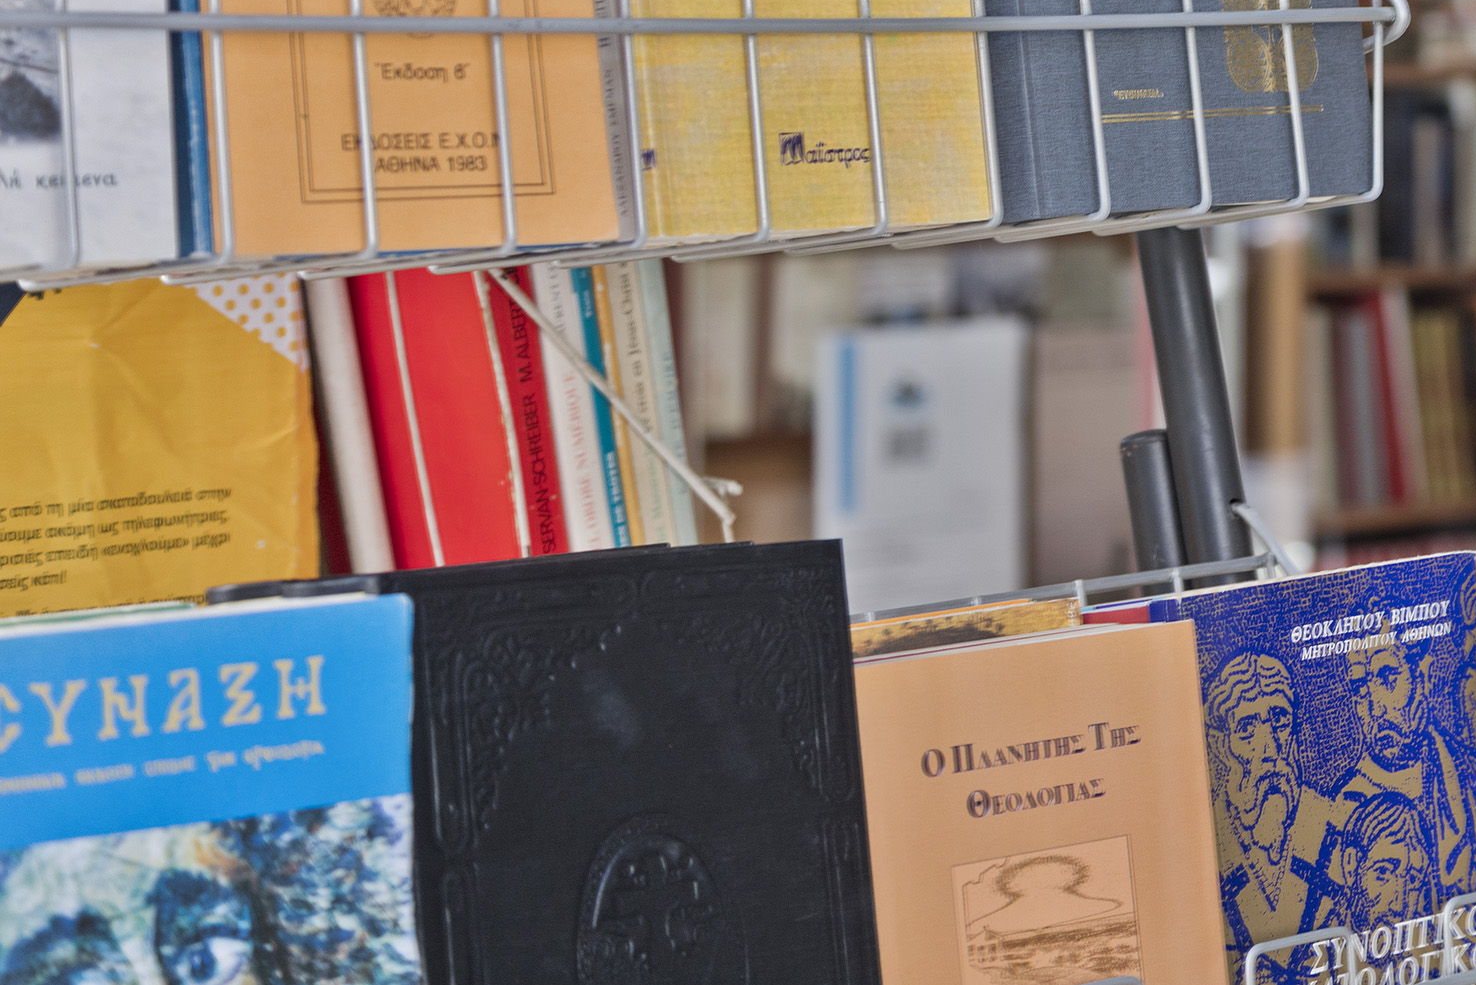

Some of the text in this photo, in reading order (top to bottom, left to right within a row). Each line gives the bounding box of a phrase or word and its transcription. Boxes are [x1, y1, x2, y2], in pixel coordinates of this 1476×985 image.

[374, 154, 488, 174] ΑΘΗΝΑ 1983
[520, 392, 556, 556] SERVAN-SCHREIBER
[1291, 600, 1452, 644] ΘΕΟΚΛΗΤΟΥ ΒΙΜΠΟΥ
[1301, 621, 1452, 661] ΜΗΤΡΟΠΟΛΙΤΟΥ ΑΘΗΝΩΝ
